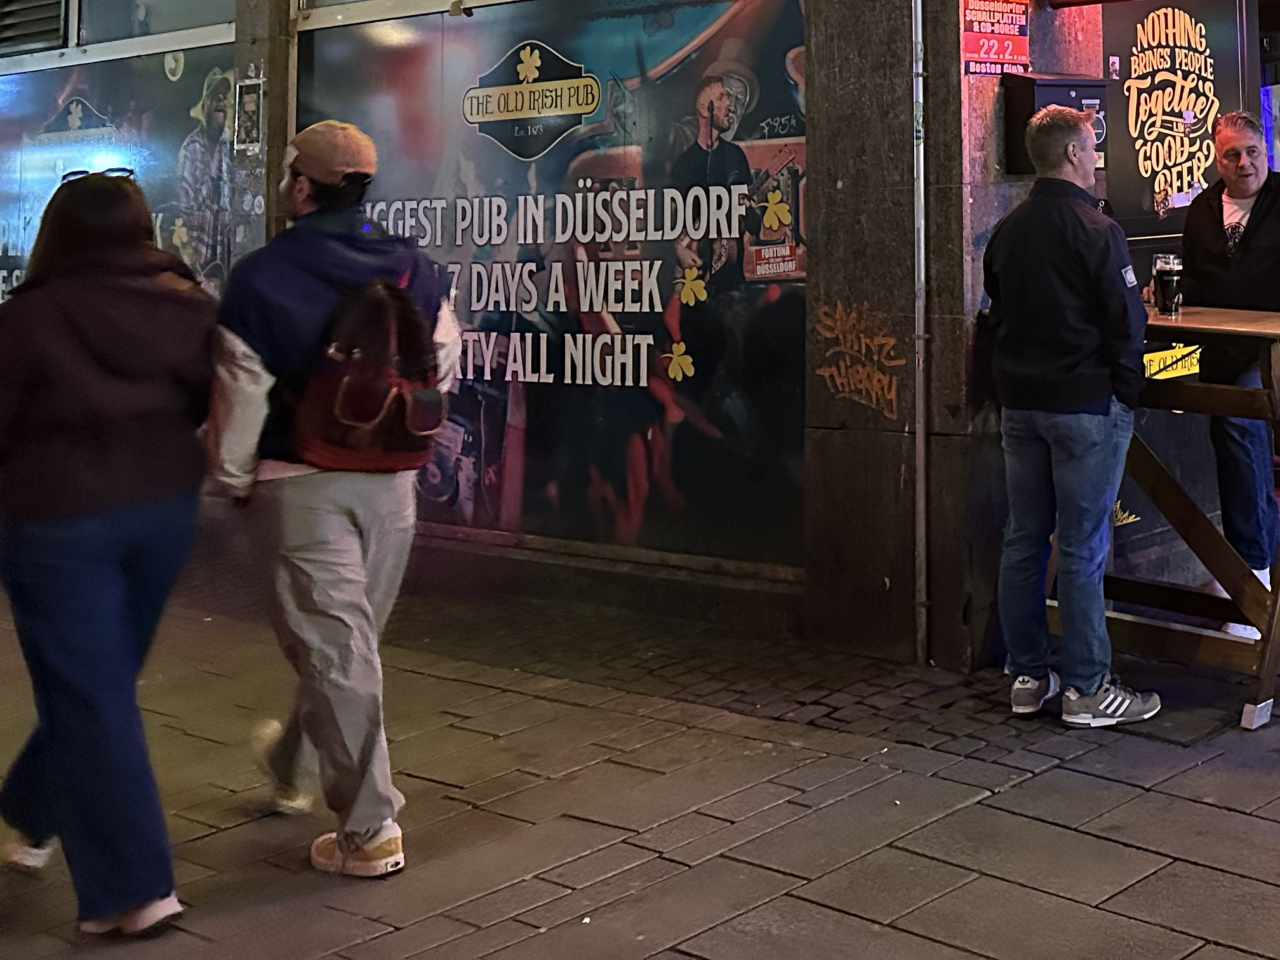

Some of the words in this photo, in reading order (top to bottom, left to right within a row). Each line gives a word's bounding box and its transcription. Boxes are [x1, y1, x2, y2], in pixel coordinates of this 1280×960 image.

[1134, 6, 1208, 53] NOTHING
[1130, 46, 1171, 79] BRINGS
[1174, 48, 1215, 81] PEOPLE
[467, 93, 495, 118] THE
[497, 90, 525, 114] OLD
[528, 86, 565, 115] IRISH
[567, 83, 596, 108] PUB
[1124, 70, 1221, 140] Together
[455, 195, 508, 248] PUB
[516, 193, 545, 245] IN
[554, 178, 749, 244] DÜSSELDORF
[761, 245, 790, 259] FORTUNA
[470, 261, 539, 313] DAYS
[547, 261, 568, 313] A
[577, 259, 664, 313] WEEK
[454, 331, 499, 381] TY
[506, 331, 555, 384] ALL
[564, 332, 655, 387] NIGHT
